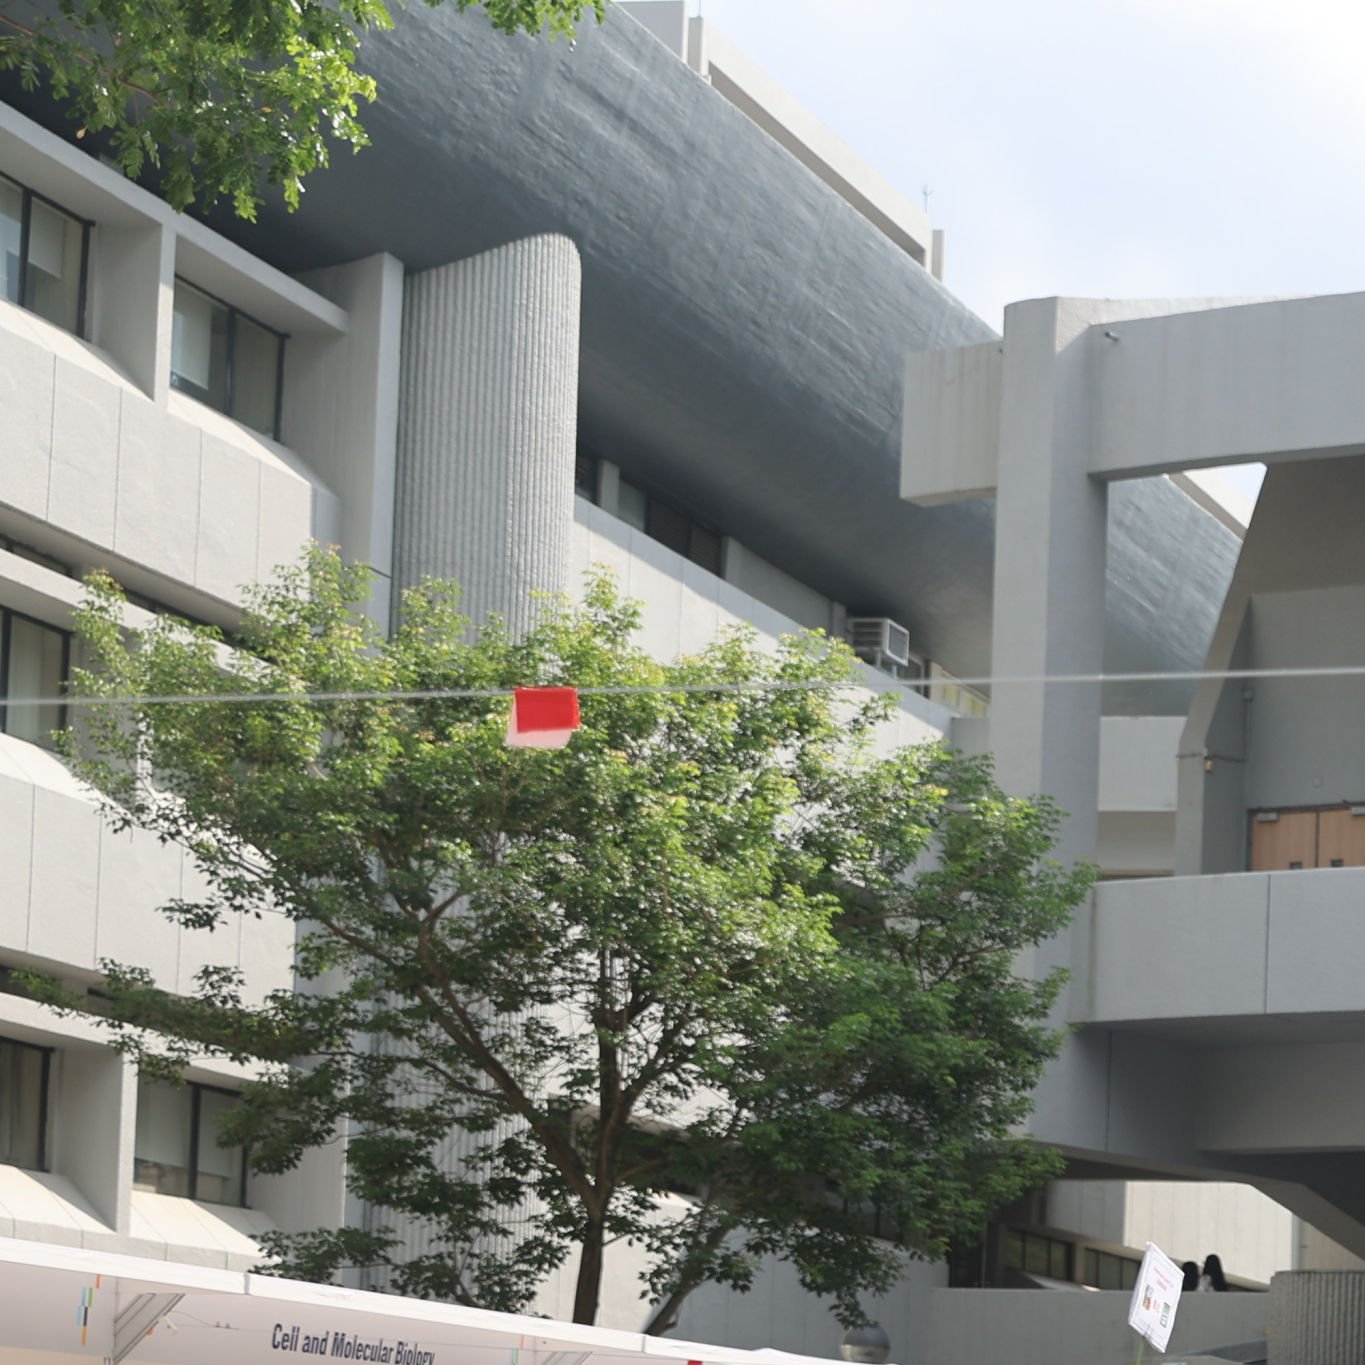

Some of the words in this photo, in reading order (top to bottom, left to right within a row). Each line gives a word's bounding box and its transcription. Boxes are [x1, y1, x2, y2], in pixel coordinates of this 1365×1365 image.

[271, 1323, 301, 1352] Cell
[302, 1331, 329, 1356] and
[331, 1332, 394, 1364] Molecular
